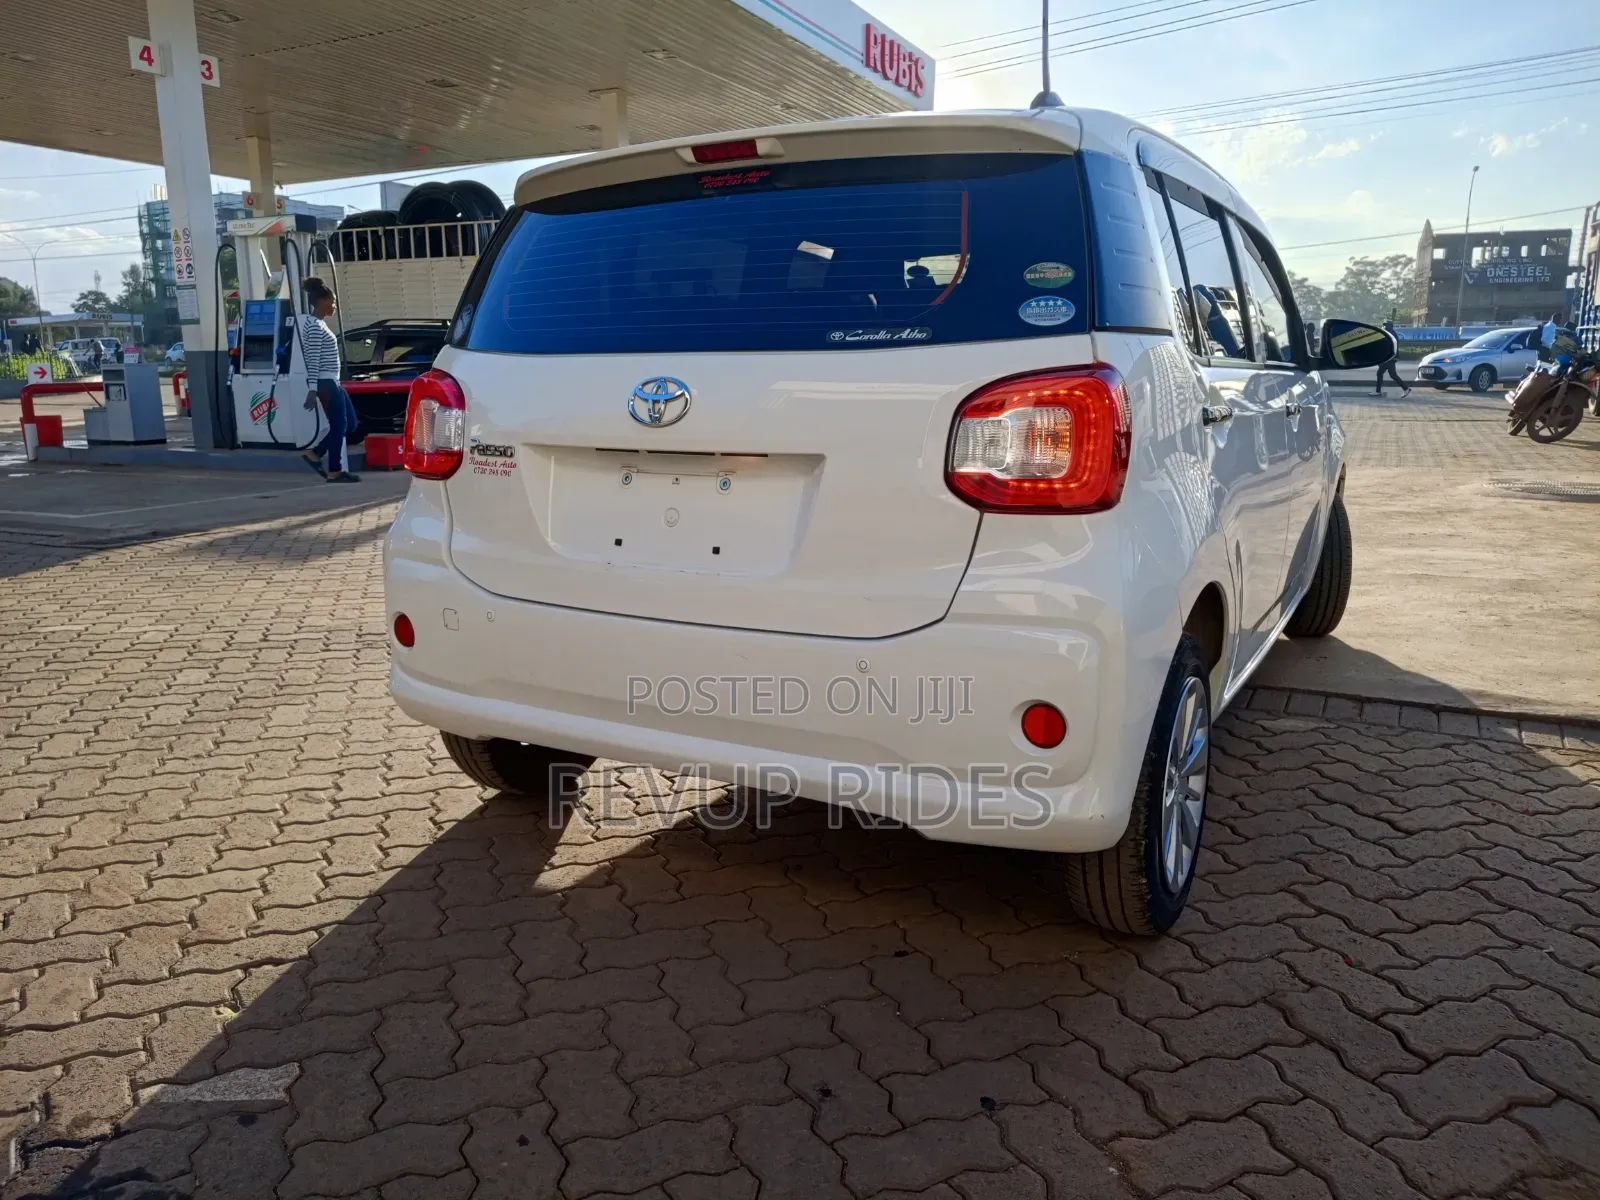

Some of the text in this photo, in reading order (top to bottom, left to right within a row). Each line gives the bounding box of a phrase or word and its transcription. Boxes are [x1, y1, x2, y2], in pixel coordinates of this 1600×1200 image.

[139, 45, 154, 67] 4
[865, 23, 925, 97] RUBiS
[201, 60, 213, 80] 3
[247, 195, 254, 206] 6
[277, 197, 283, 209] 5
[845, 330, 891, 340] Corolla
[469, 456, 517, 468] Roadest Auto
[473, 466, 487, 475] 0720
[500, 469, 512, 477] 090
